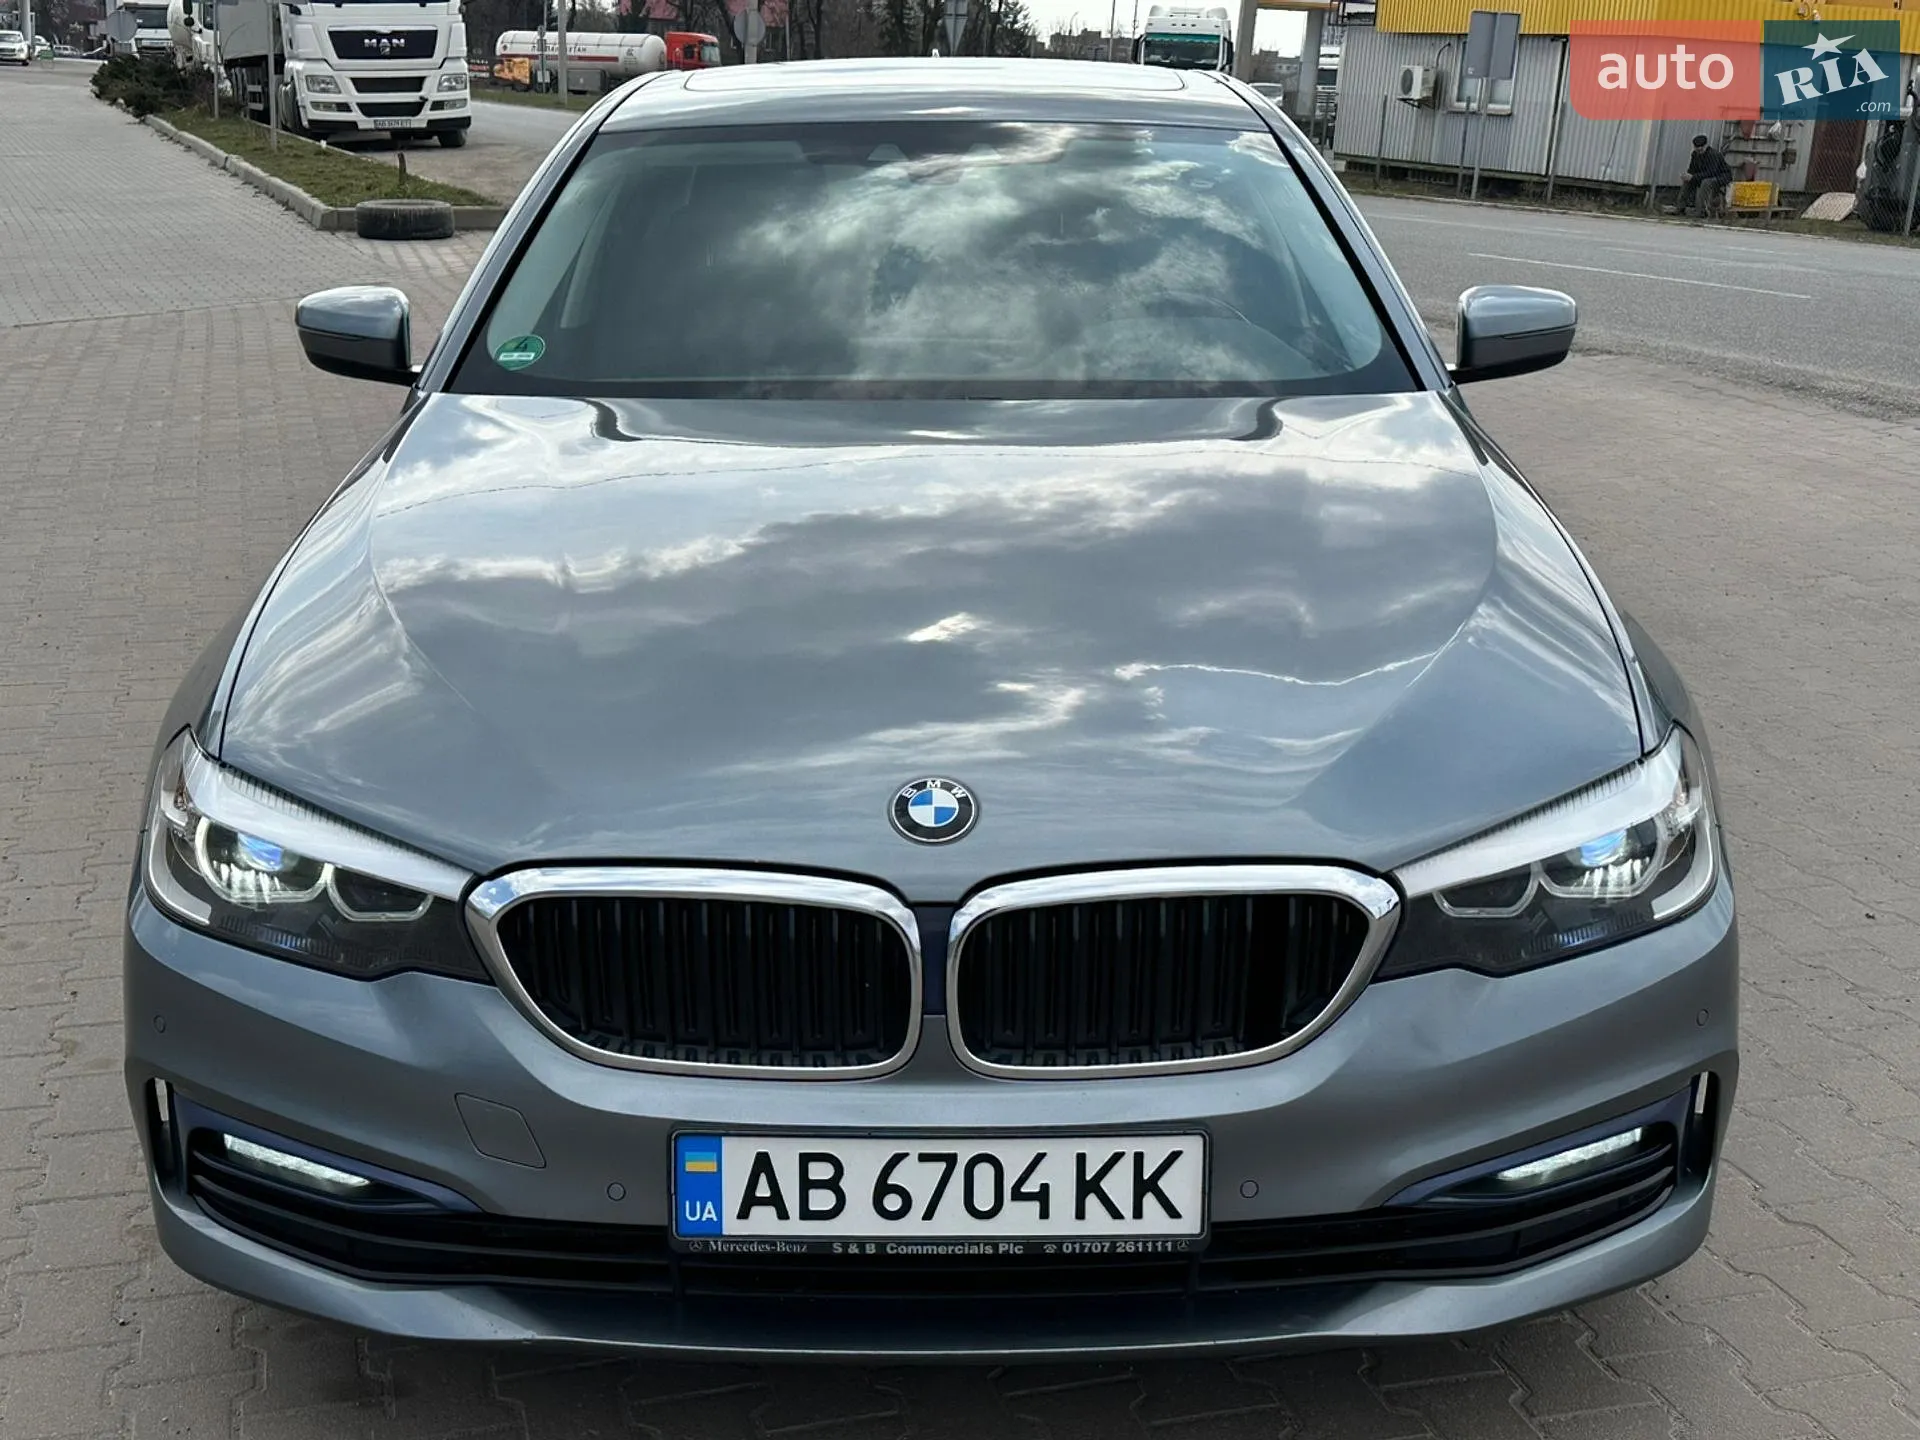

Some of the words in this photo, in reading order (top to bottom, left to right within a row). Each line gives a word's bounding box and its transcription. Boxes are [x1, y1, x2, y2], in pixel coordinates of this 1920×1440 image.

[363, 38, 405, 47] MAN
[901, 779, 967, 798] BMW
[735, 1151, 848, 1221] AB
[871, 1152, 1050, 1221] 6704
[1074, 1150, 1184, 1221] KK
[684, 1200, 718, 1222] UA
[708, 1240, 808, 1253] Mercedes-Benz
[832, 1242, 843, 1254] S
[847, 1242, 860, 1254] &
[865, 1242, 877, 1254] B
[886, 1242, 993, 1254] Commercials
[998, 1242, 1024, 1254] Plc
[1062, 1242, 1109, 1254] 01707
[1115, 1241, 1173, 1253] 261111
